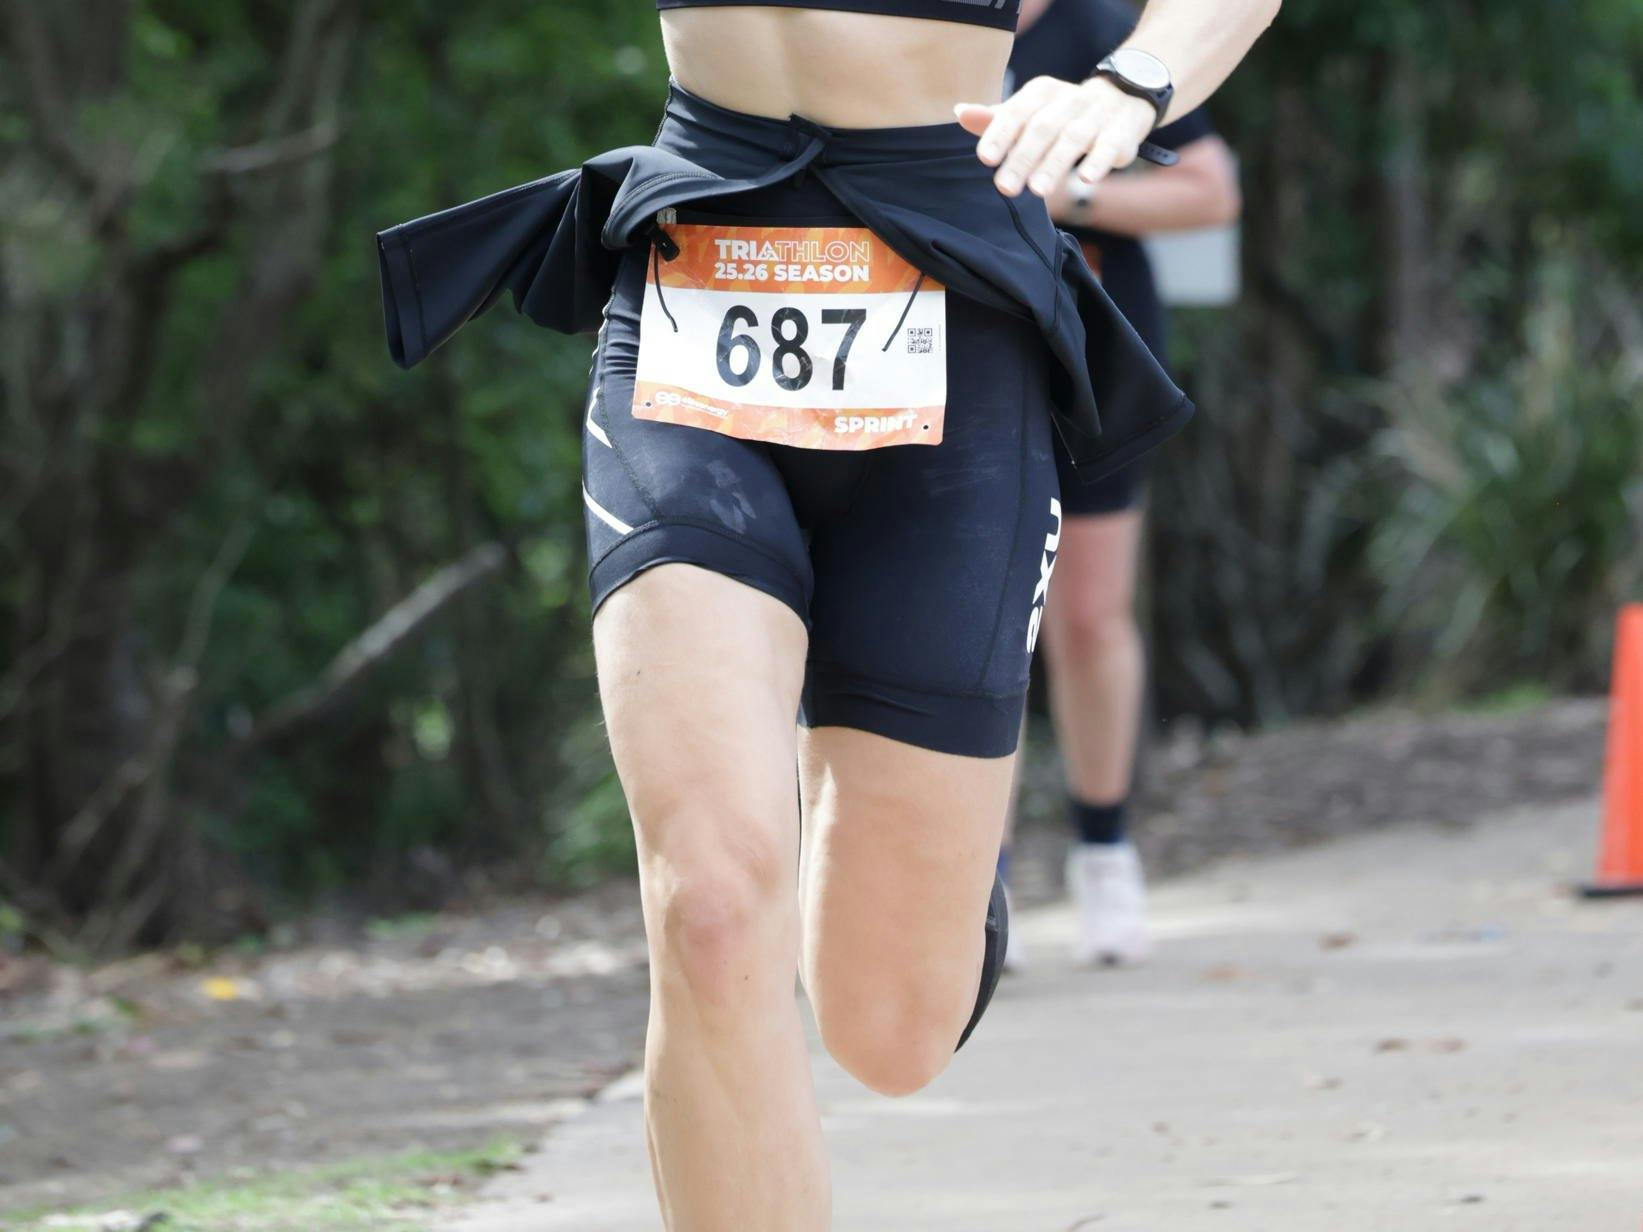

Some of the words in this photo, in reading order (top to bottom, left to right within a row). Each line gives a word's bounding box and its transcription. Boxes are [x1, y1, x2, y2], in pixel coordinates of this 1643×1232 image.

[714, 239, 870, 262] TRIATHLON
[714, 262, 768, 280] 25.26
[774, 264, 869, 282] SEASON
[716, 304, 867, 392] 687
[833, 413, 918, 434] SPRINT
